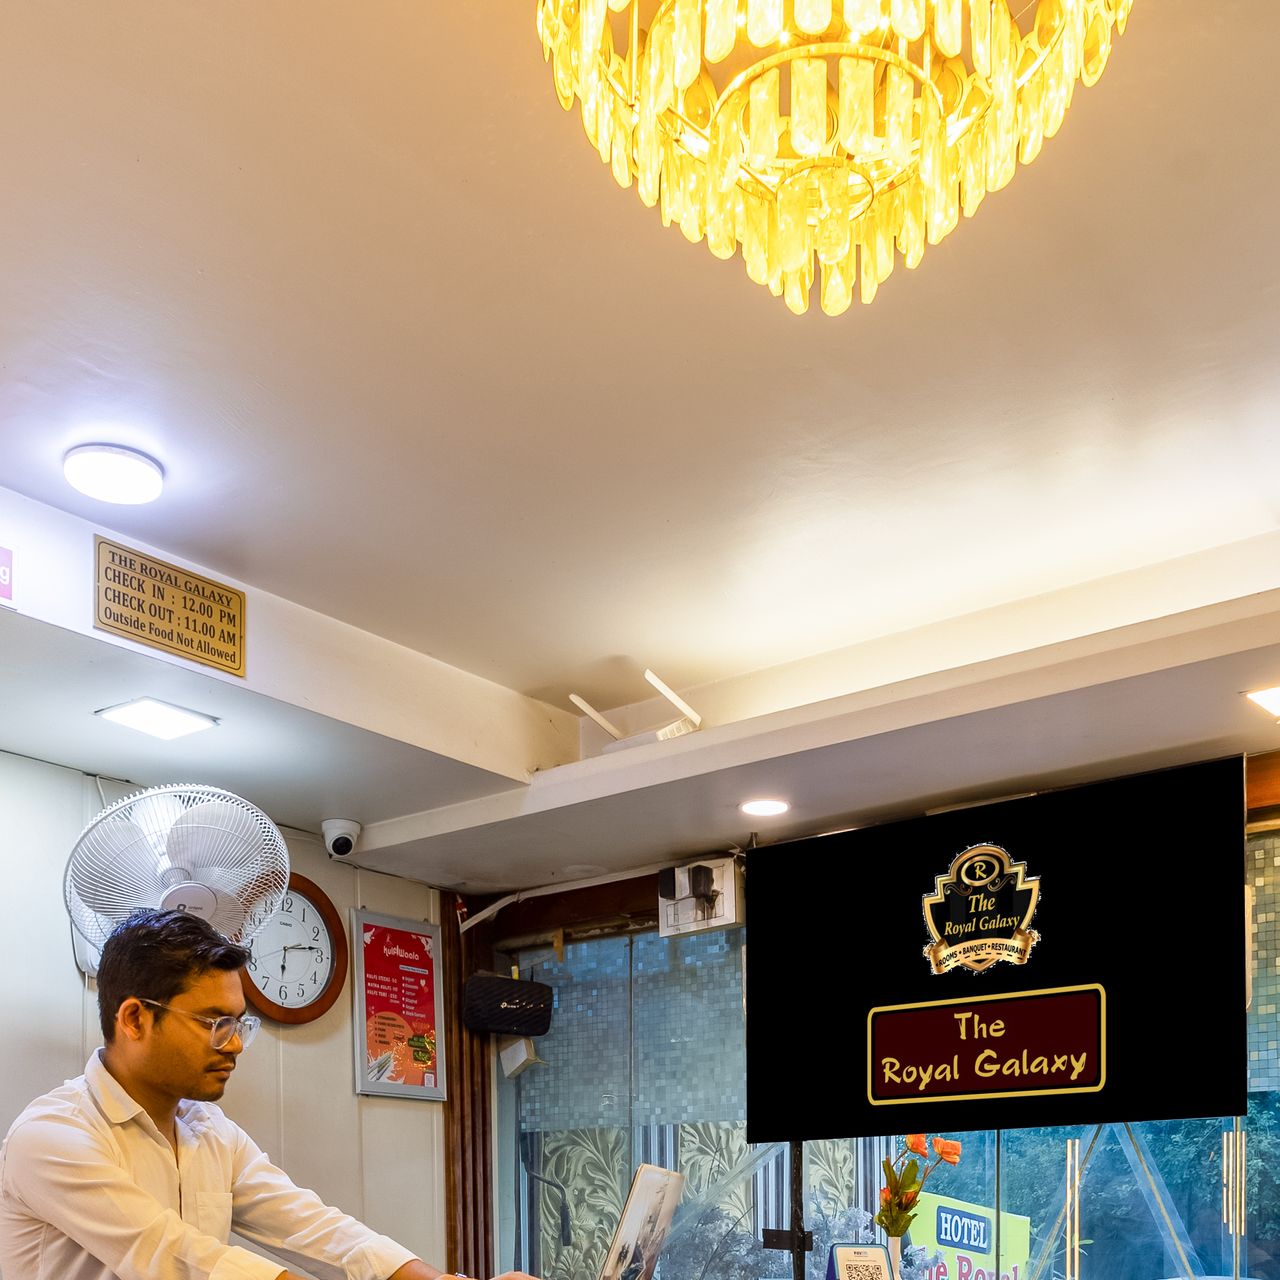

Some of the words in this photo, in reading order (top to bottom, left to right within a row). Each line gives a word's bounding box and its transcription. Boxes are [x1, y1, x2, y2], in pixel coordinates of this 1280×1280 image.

[109, 551, 137, 571] THE
[140, 563, 181, 588] ROYAL
[184, 581, 233, 607] GALAXY
[104, 566, 145, 594] CHECK
[152, 584, 165, 600] IN
[182, 595, 213, 618] 12.00
[220, 609, 236, 627] PM
[104, 587, 145, 614] CHECK
[149, 603, 174, 623] OUT
[185, 616, 216, 638] 11.00
[218, 629, 236, 646] AM
[104, 607, 146, 631] Outside
[149, 622, 173, 641] Food
[177, 632, 194, 649] Not
[196, 641, 236, 664] Allowed
[974, 862, 987, 879] R
[281, 897, 293, 913] 12
[968, 893, 996, 913] The
[302, 908, 306, 922] 1
[312, 926, 320, 941] 2
[944, 918, 976, 937] Royal
[980, 914, 1020, 930] Galaxy
[315, 949, 324, 963] 3
[938, 951, 958, 967] ROOMS
[962, 943, 987, 955] BANQUET
[991, 943, 1027, 956] RESTAURANT
[249, 957, 258, 972] 8
[262, 976, 270, 990] 7
[310, 971, 317, 984] 4
[279, 985, 288, 1001] 6
[297, 983, 305, 997] 5
[954, 1011, 1006, 1040] The
[881, 1054, 960, 1091] Royal
[974, 1049, 1087, 1081] Galaxy
[940, 1212, 988, 1248] HOTEL
